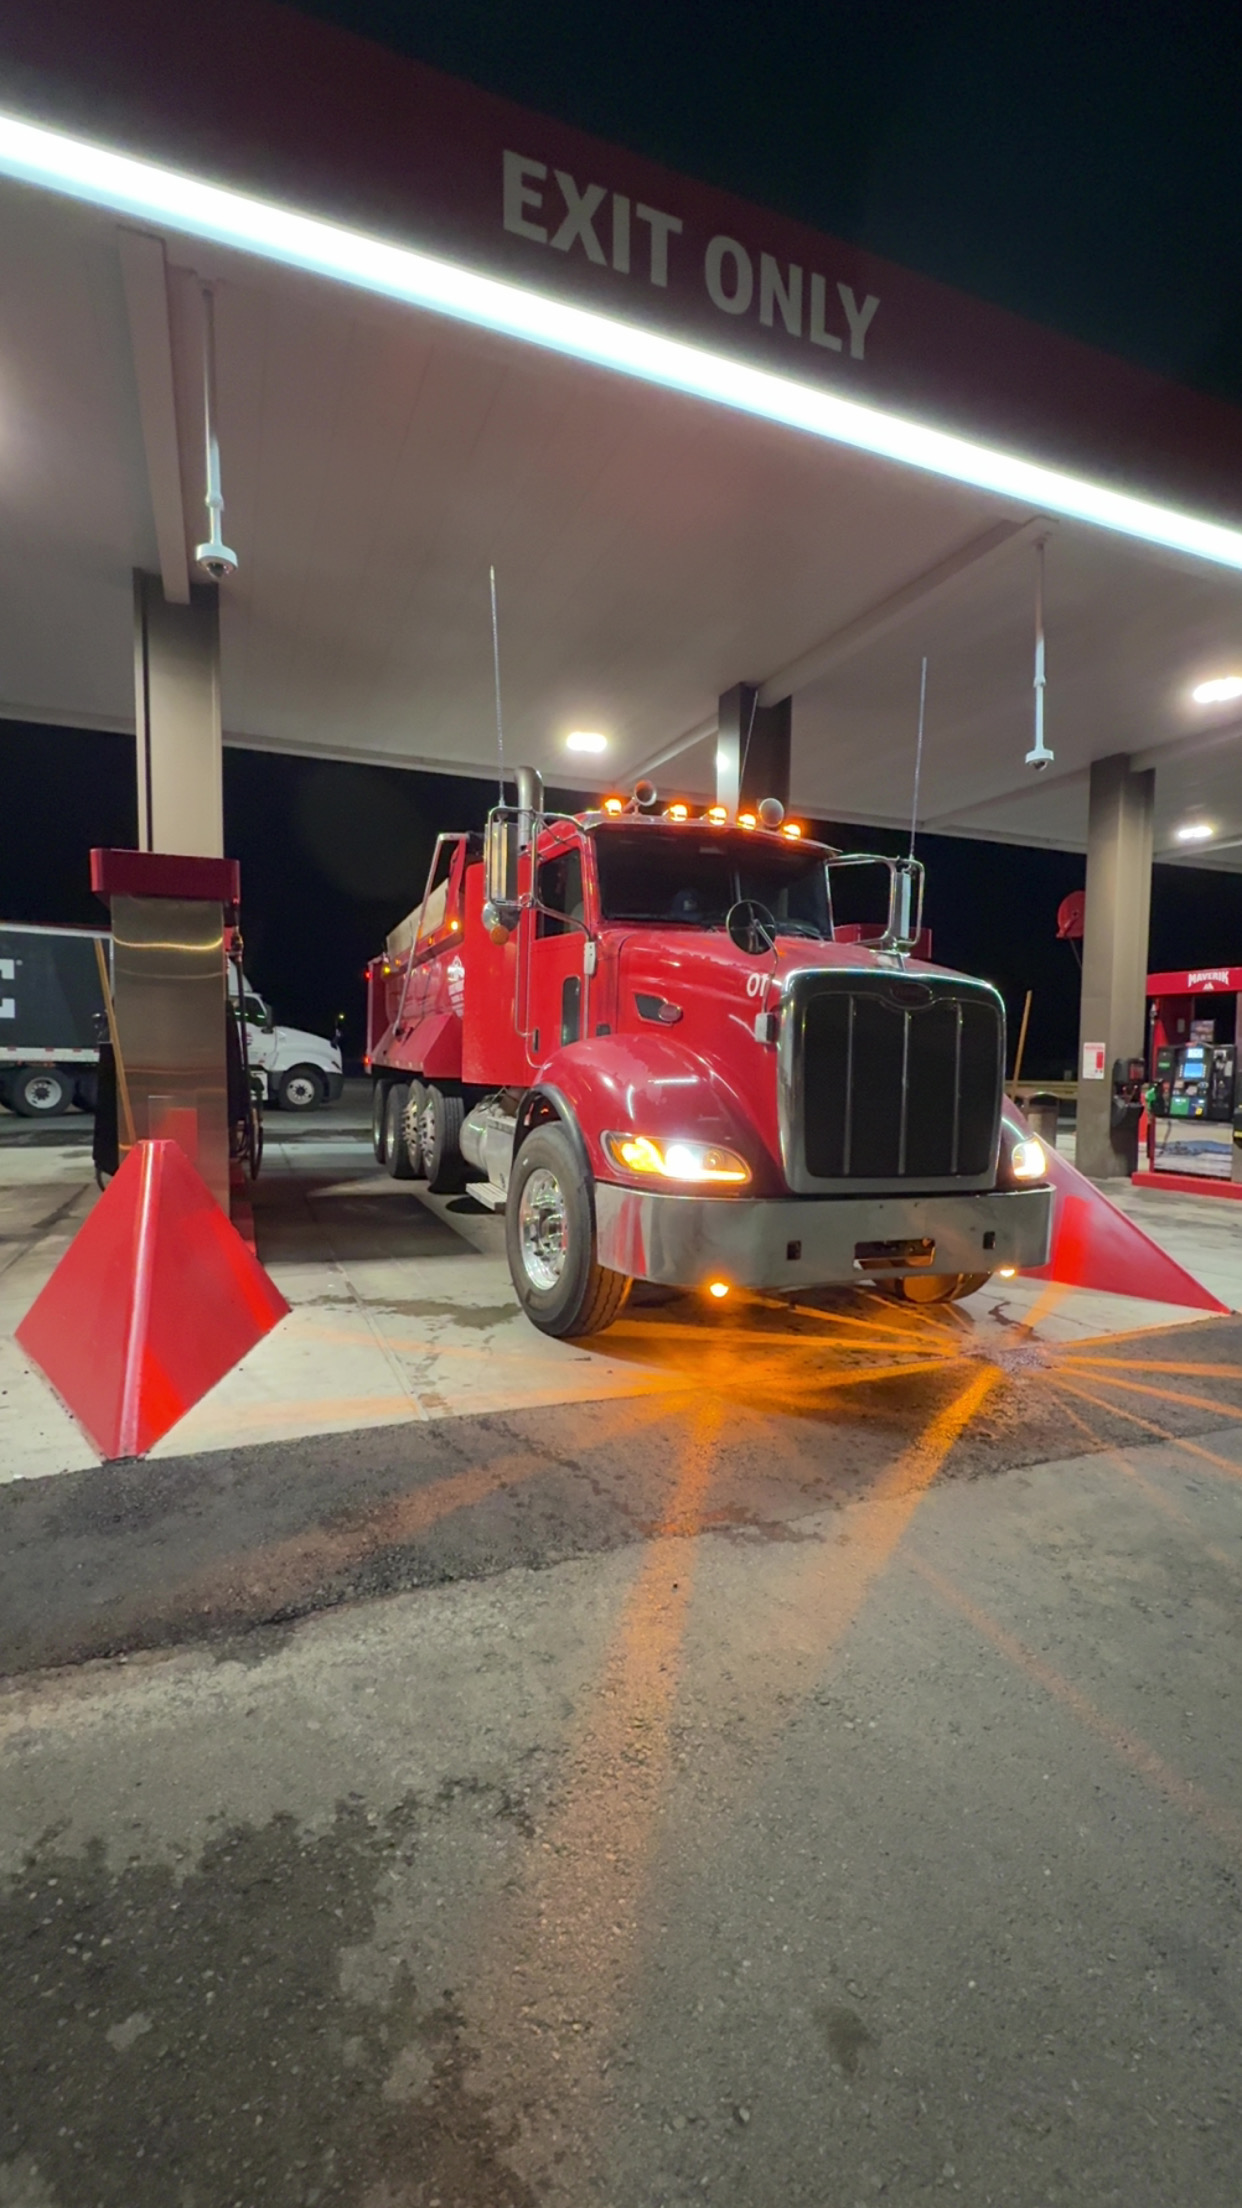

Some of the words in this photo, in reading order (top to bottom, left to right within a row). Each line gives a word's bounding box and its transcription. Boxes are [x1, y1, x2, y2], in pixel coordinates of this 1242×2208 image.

[503, 149, 683, 288] EXIT
[704, 234, 880, 361] ONLY
[1187, 970, 1230, 988] MAVERIK
